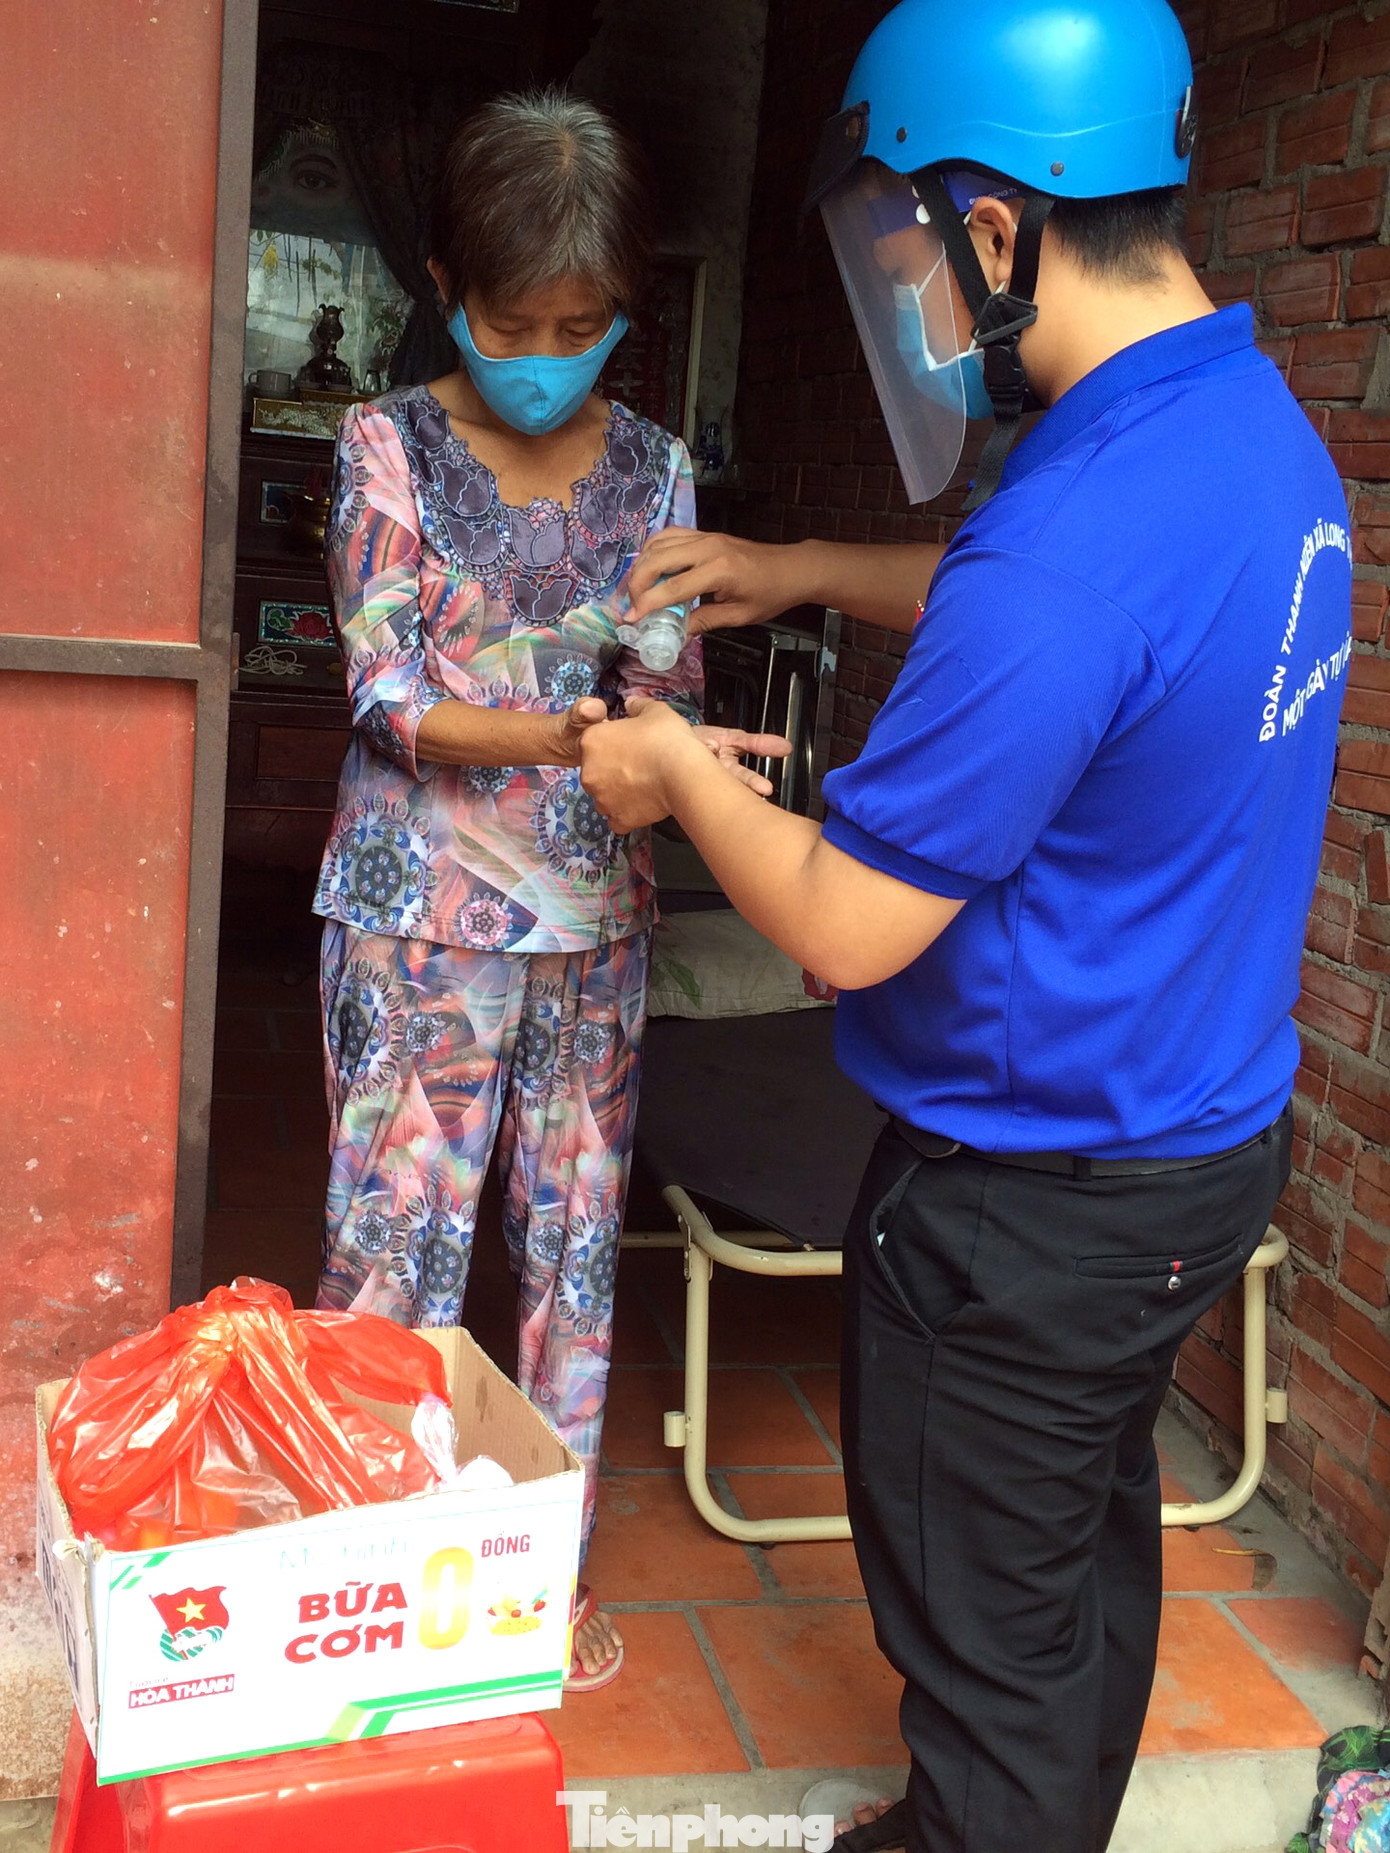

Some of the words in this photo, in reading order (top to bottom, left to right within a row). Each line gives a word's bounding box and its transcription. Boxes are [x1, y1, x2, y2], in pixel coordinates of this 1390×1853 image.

[1259, 665, 1286, 742] ĐOÀN
[1324, 522, 1346, 553] LONG
[1282, 688, 1306, 737] MỘT
[298, 1581, 408, 1623] BỮA
[418, 1546, 475, 1650] 0
[284, 1620, 404, 1664] CƠM
